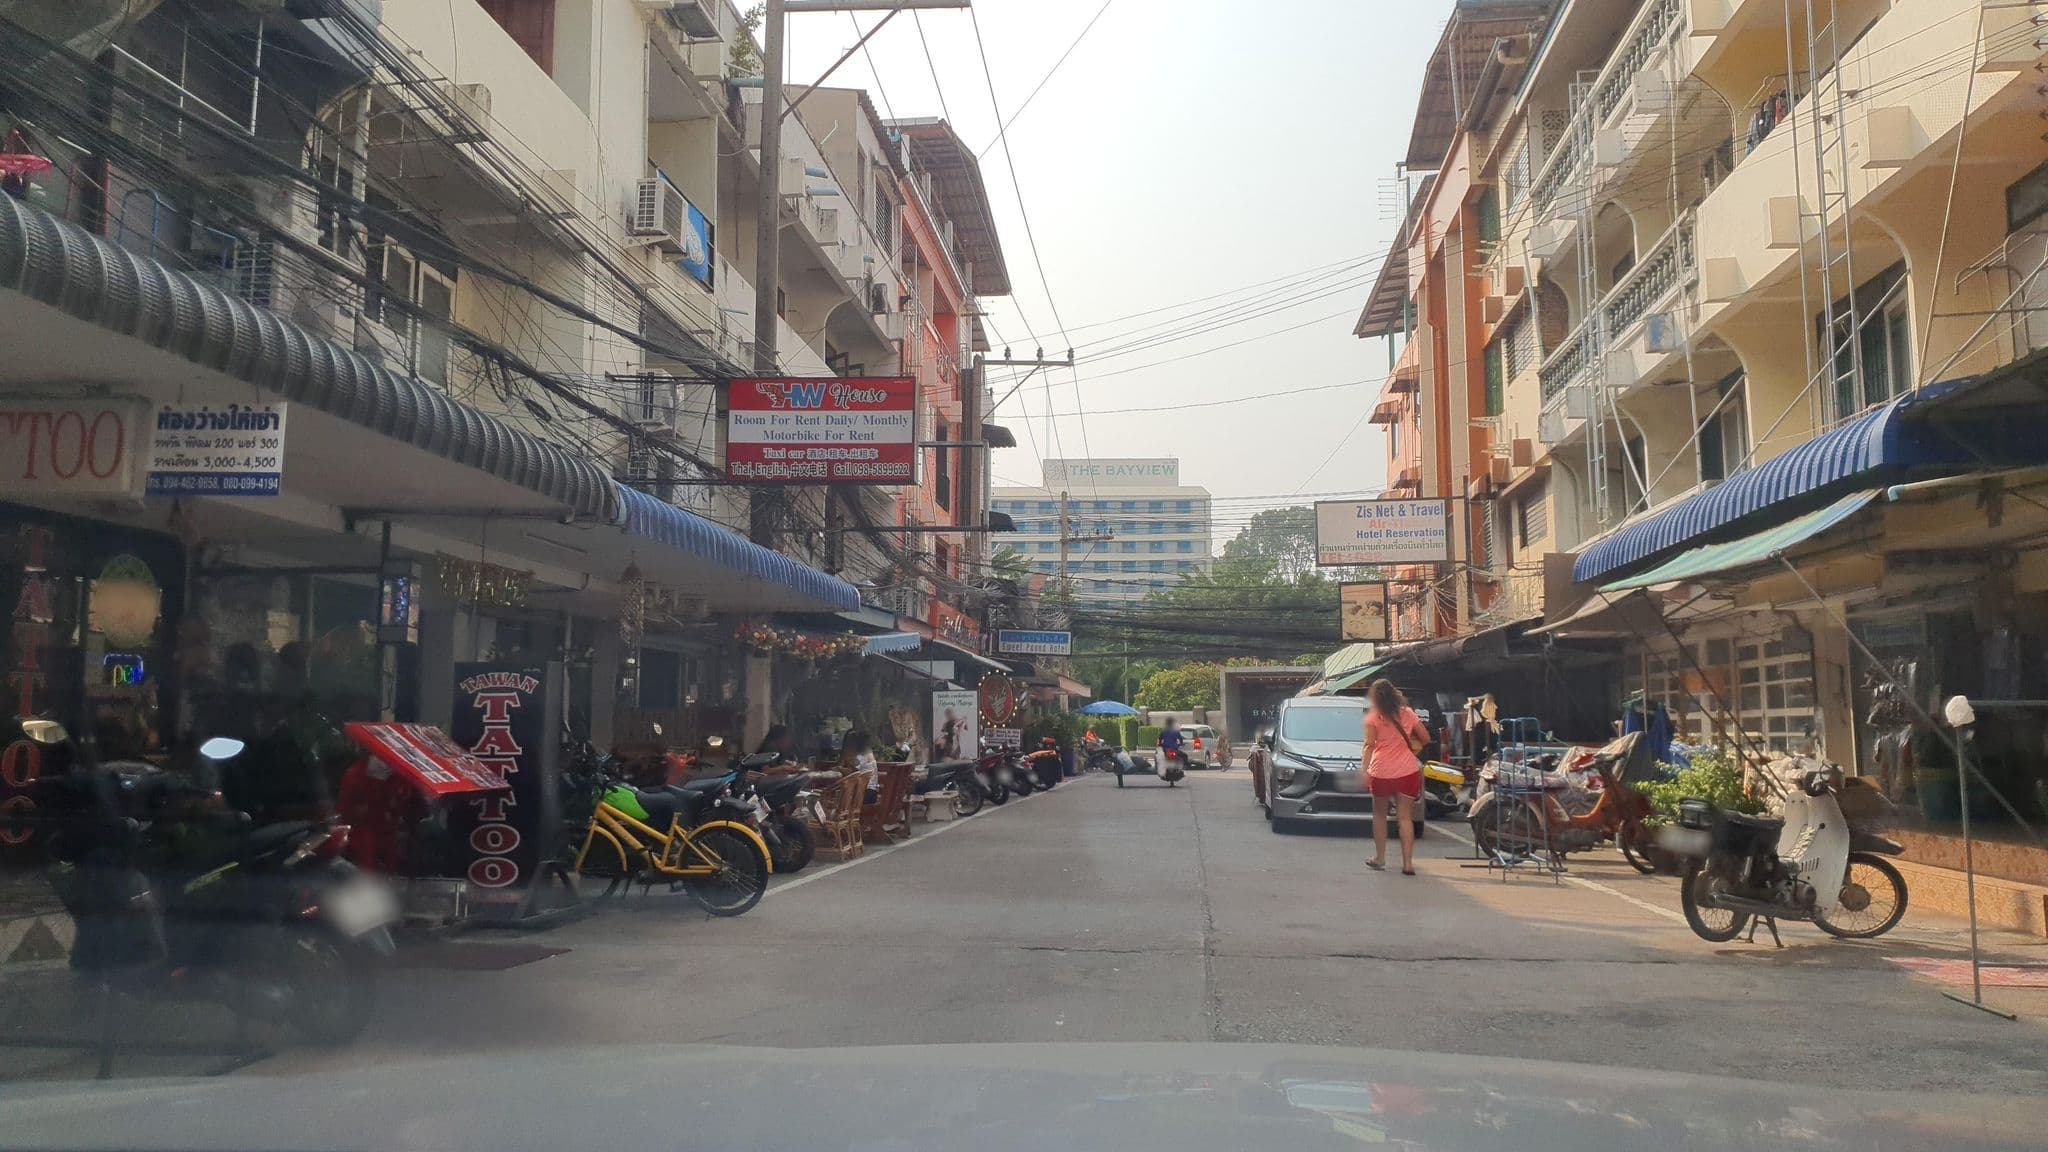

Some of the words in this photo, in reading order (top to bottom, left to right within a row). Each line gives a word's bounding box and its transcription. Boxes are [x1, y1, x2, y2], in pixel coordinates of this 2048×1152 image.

[829, 384, 887, 409] House
[157, 403, 280, 430] ห้องว่างให้เช่า
[734, 414, 766, 426] Room
[771, 414, 791, 426] For
[795, 414, 820, 426] Rent
[825, 414, 858, 428] Daily/
[864, 414, 909, 428] Monthly
[763, 430, 820, 441] Motorbike
[825, 431, 845, 441] For
[849, 431, 875, 441] Rent
[214, 437, 234, 449] 200
[260, 438, 279, 449] 300
[763, 448, 787, 460] Taxi
[788, 450, 804, 460] car
[731, 463, 755, 478] Thai,
[834, 463, 851, 477] Call
[1070, 464, 1100, 476] THE
[1106, 464, 1176, 476] BAYVIEW
[1356, 506, 1372, 518] Zis
[1376, 505, 1394, 517] Net
[1398, 504, 1406, 517] &
[1410, 503, 1444, 516] Travel
[1356, 530, 1382, 539] Hotel
[1386, 528, 1444, 538] Reservation
[460, 672, 539, 694] TAWAN
